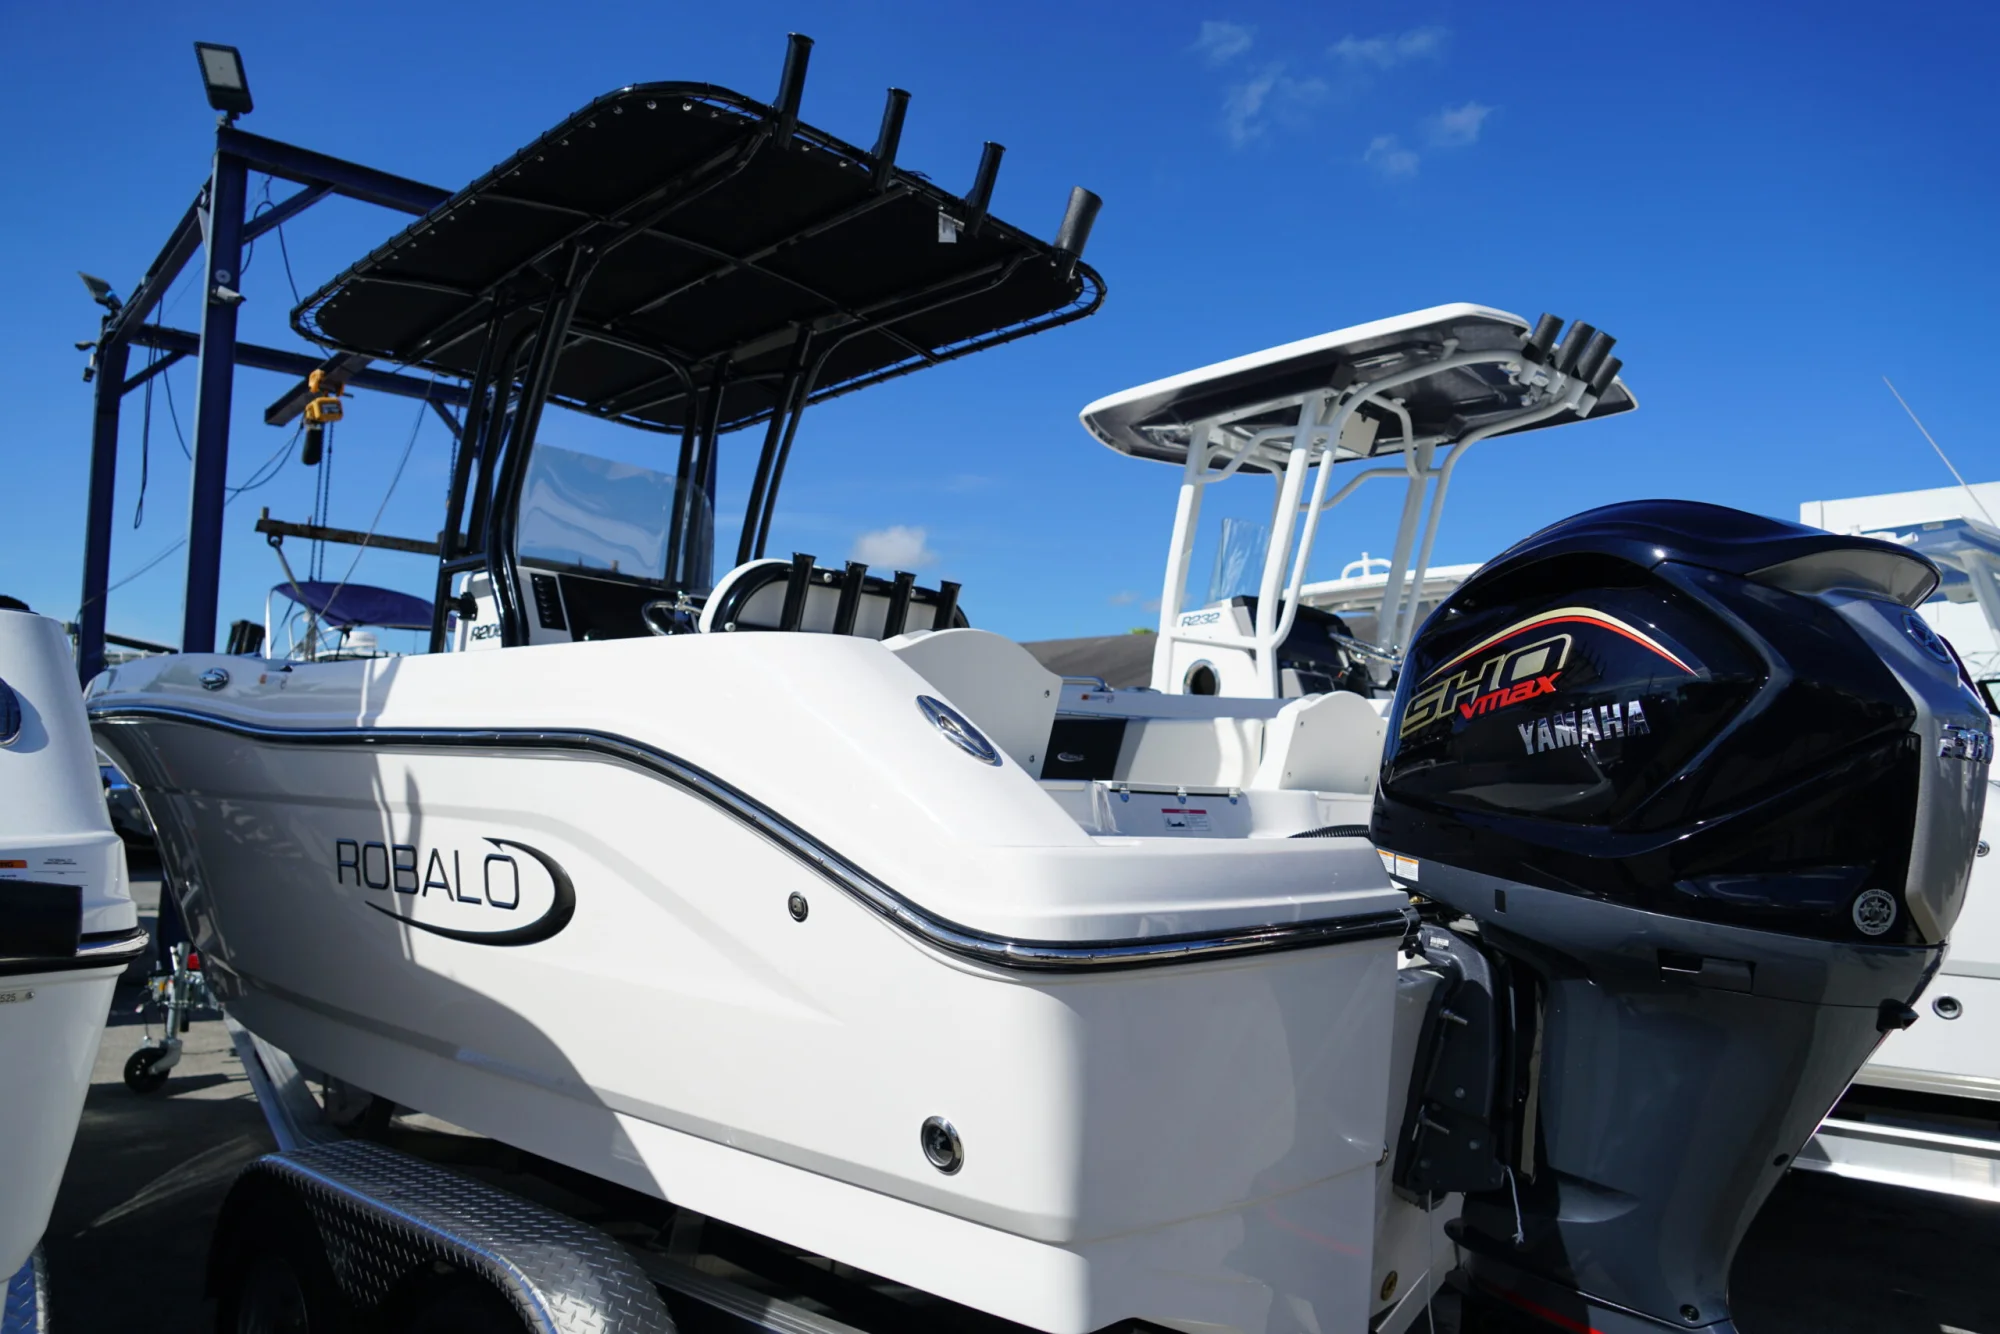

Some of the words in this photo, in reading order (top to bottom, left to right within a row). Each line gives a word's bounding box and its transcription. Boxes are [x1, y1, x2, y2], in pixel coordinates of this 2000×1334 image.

[1181, 612, 1221, 627] R232
[1399, 633, 1573, 739] SHO
[1517, 699, 1651, 756] YAMAHA
[336, 838, 520, 911] ROBALO
